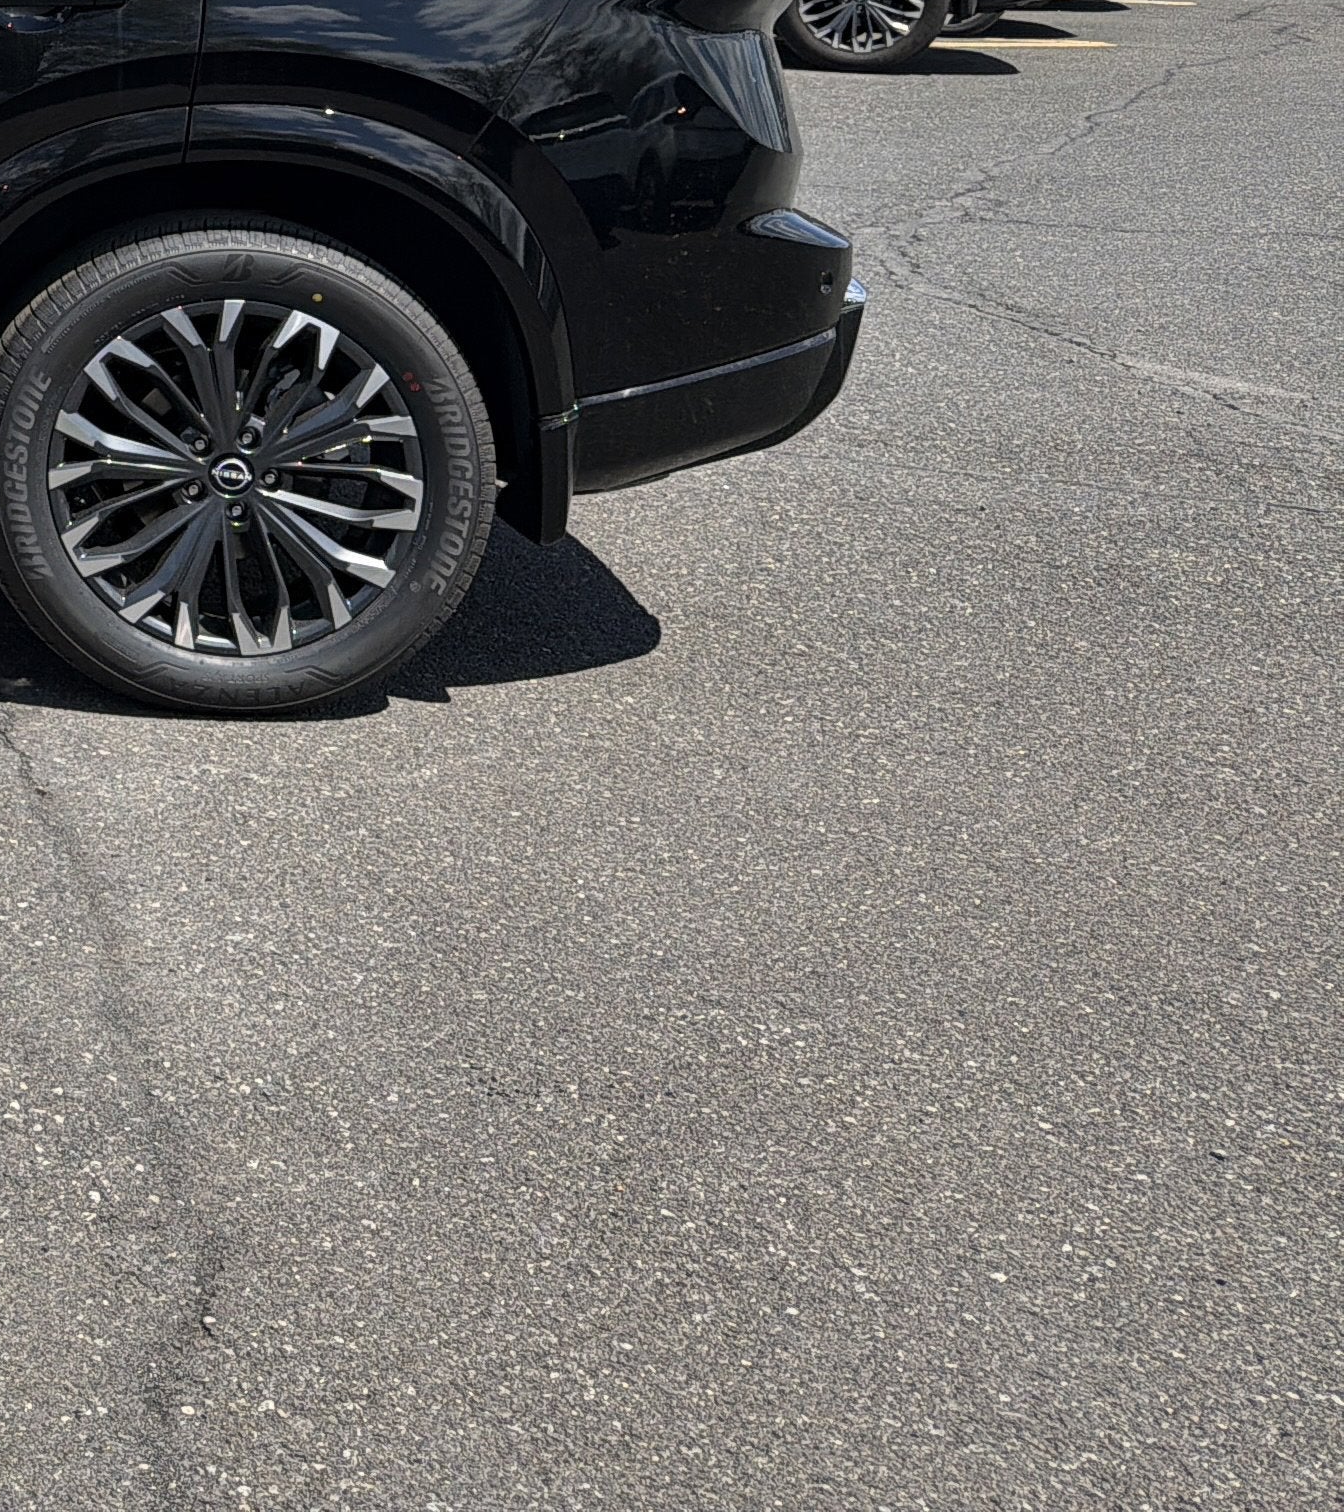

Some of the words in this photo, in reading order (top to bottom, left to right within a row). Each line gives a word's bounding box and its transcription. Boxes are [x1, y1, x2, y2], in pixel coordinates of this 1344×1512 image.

[3, 370, 54, 580] BRIDGESTONE
[211, 468, 253, 492] NISSAN
[423, 376, 474, 595] BRIDGESTONE
